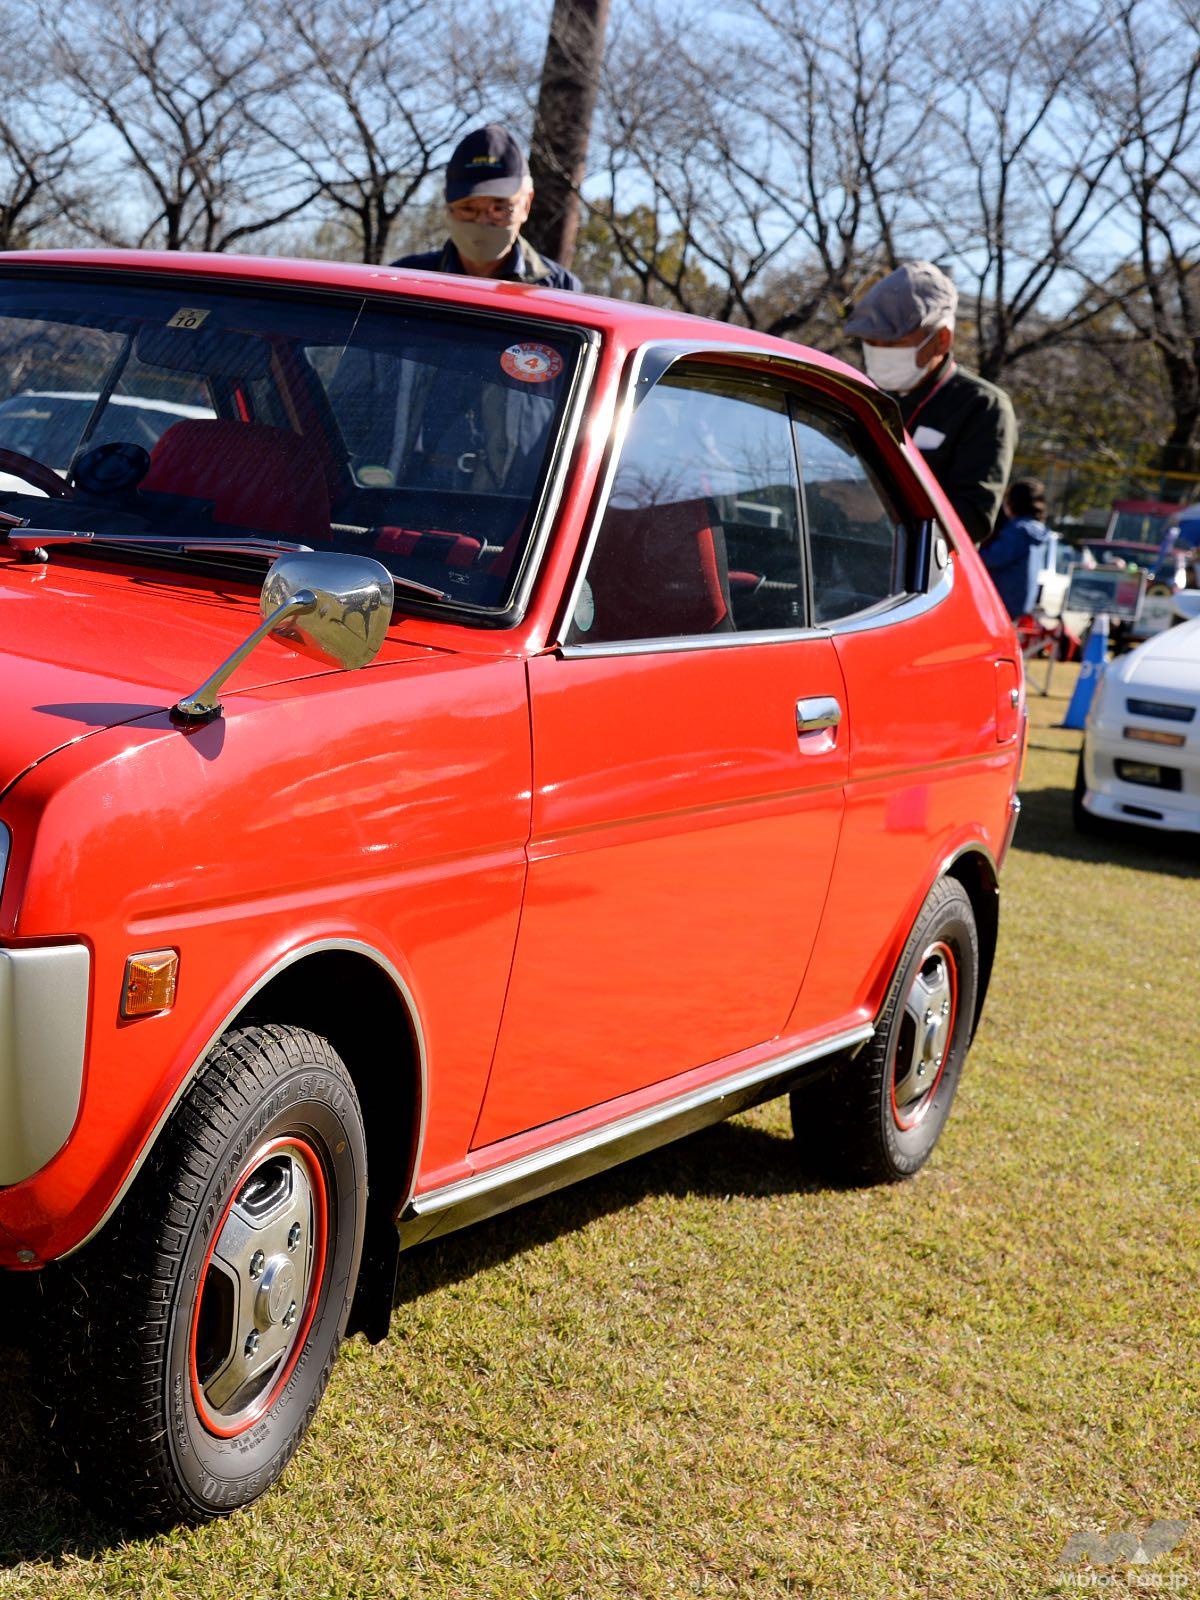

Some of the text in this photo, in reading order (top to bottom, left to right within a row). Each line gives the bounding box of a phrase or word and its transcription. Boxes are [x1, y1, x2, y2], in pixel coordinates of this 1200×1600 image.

[176, 317, 196, 327] 10
[524, 357, 540, 369] 4
[200, 1075, 345, 1241] DUNLOP SP10
